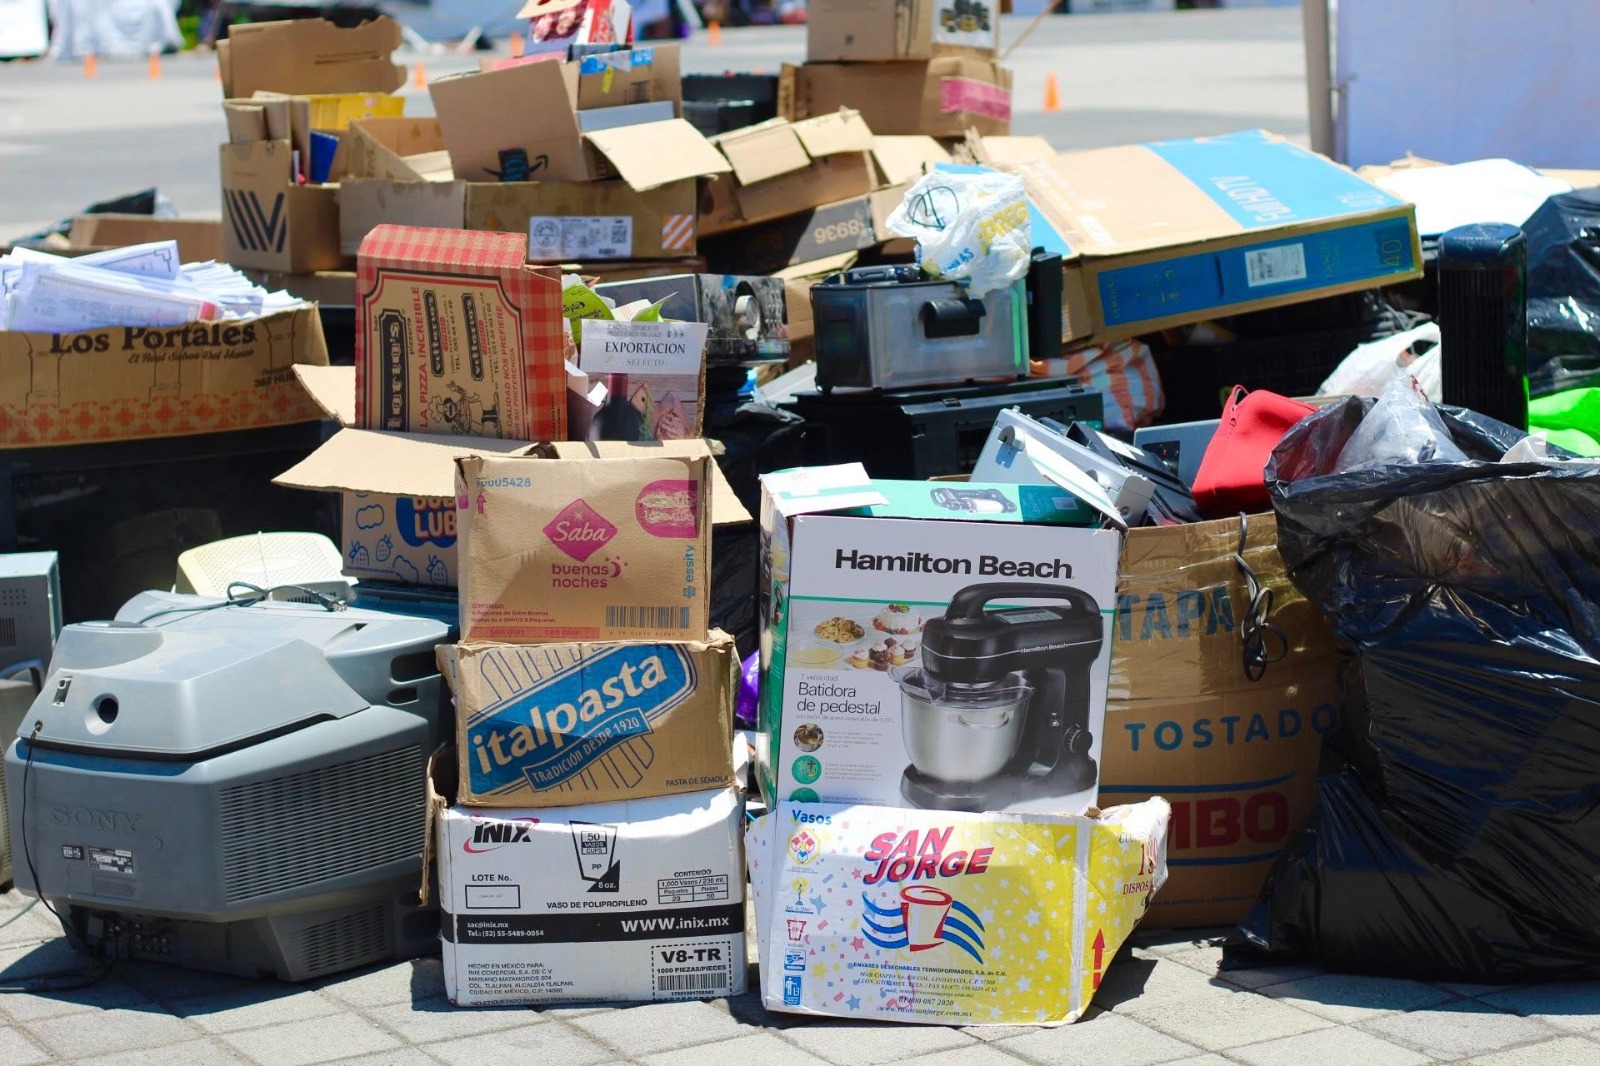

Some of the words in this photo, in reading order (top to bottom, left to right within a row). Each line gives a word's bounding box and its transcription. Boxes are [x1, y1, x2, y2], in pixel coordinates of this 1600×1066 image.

[411, 286, 427, 359] INCREIBLE
[495, 305, 508, 356] PREFIERE
[49, 331, 110, 354] Los
[121, 322, 258, 351] Portales
[406, 317, 415, 355] pizzeria
[605, 341, 686, 354] EXPORTACION
[499, 358, 510, 380] NOS
[626, 359, 665, 367] SELECTO
[419, 362, 429, 403] PIZZA
[509, 347, 518, 408] PREFERENCIA
[502, 382, 513, 427] CALIDAD
[419, 410, 429, 428] LA
[512, 409, 519, 422] SU
[552, 520, 610, 541] Saba
[552, 563, 609, 575] buenas
[684, 545, 696, 582] essity
[835, 548, 972, 575] Hamilton
[978, 554, 1073, 579] Beach
[552, 577, 608, 588] noches
[1117, 583, 1238, 642] TAPA
[562, 628, 580, 636] alas
[1020, 645, 1048, 654] Hamilton
[1048, 642, 1069, 650] Beach
[798, 681, 857, 698] Batidora
[472, 655, 667, 775] italpasta
[796, 698, 816, 712] de
[819, 700, 881, 715] pedestal
[613, 716, 641, 734] 1920
[1124, 702, 1339, 752] TOSTADO
[665, 778, 688, 786] PASTA
[688, 777, 699, 785] DE
[700, 775, 729, 784] SÉMOLA
[50, 802, 143, 833] SONY
[792, 809, 832, 826] Vasos
[473, 821, 532, 844] INIX
[587, 832, 601, 842] 50
[863, 826, 955, 862] SAN
[674, 868, 712, 878] CONTENIDO
[862, 846, 995, 886] JORGE
[472, 874, 495, 882] LOTE
[498, 874, 512, 882] No.
[598, 881, 604, 889] 8
[661, 880, 679, 888] 1,000
[546, 902, 569, 910] VASO
[570, 901, 582, 909] DE
[583, 899, 648, 908] POLIPROPILENO
[467, 921, 509, 929] sac@inix.mx
[661, 948, 722, 963] V8-TR
[674, 964, 727, 973] PIEZAS/PIECES
[880, 964, 921, 972] DESECHABLES
